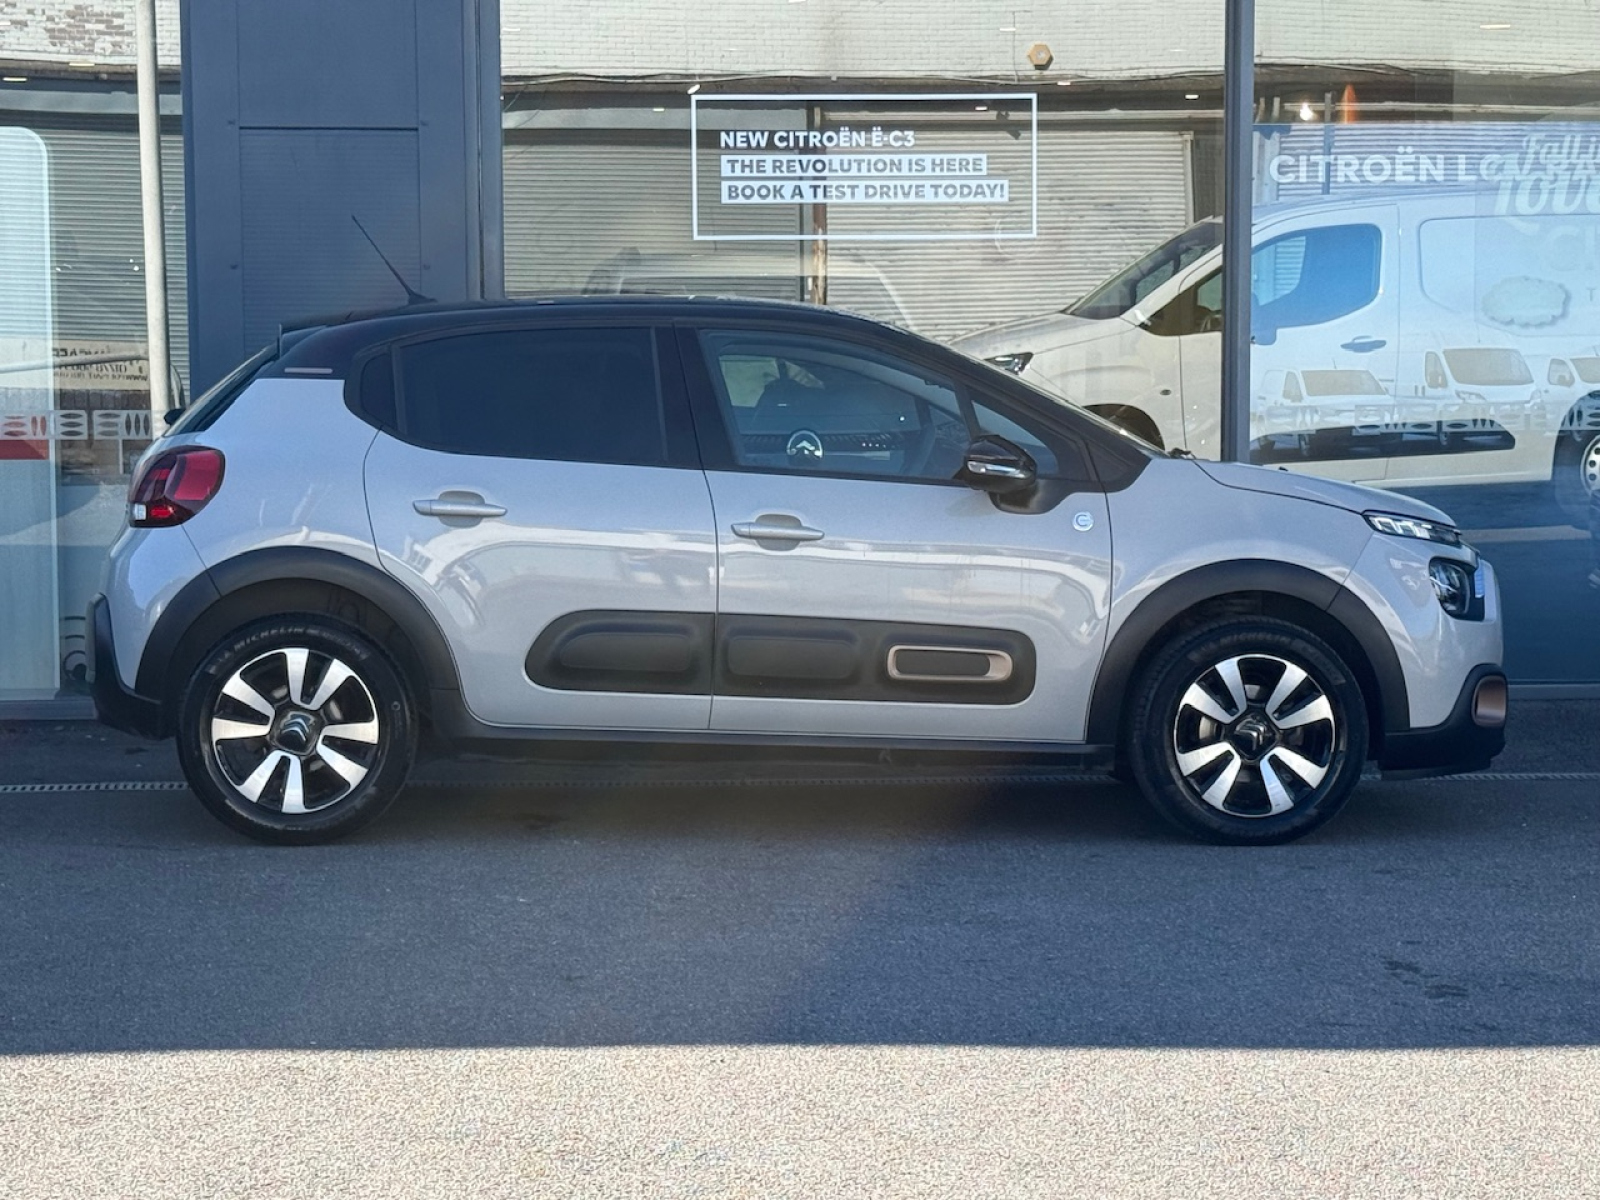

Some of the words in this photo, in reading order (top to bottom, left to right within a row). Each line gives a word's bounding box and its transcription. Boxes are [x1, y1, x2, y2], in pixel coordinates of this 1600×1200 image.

[719, 131, 769, 148] NEW
[774, 126, 866, 148] CITROËN
[726, 158, 767, 174] THE
[771, 158, 903, 174] REVOLUTION
[907, 157, 927, 174] IS
[930, 157, 983, 173] HERE
[1269, 146, 1445, 184] CITROËN
[727, 185, 785, 201] BOOK
[789, 185, 805, 200] A
[808, 184, 860, 200] TEST
[864, 183, 926, 199] DRIVE
[929, 182, 1006, 199] TODAY!
